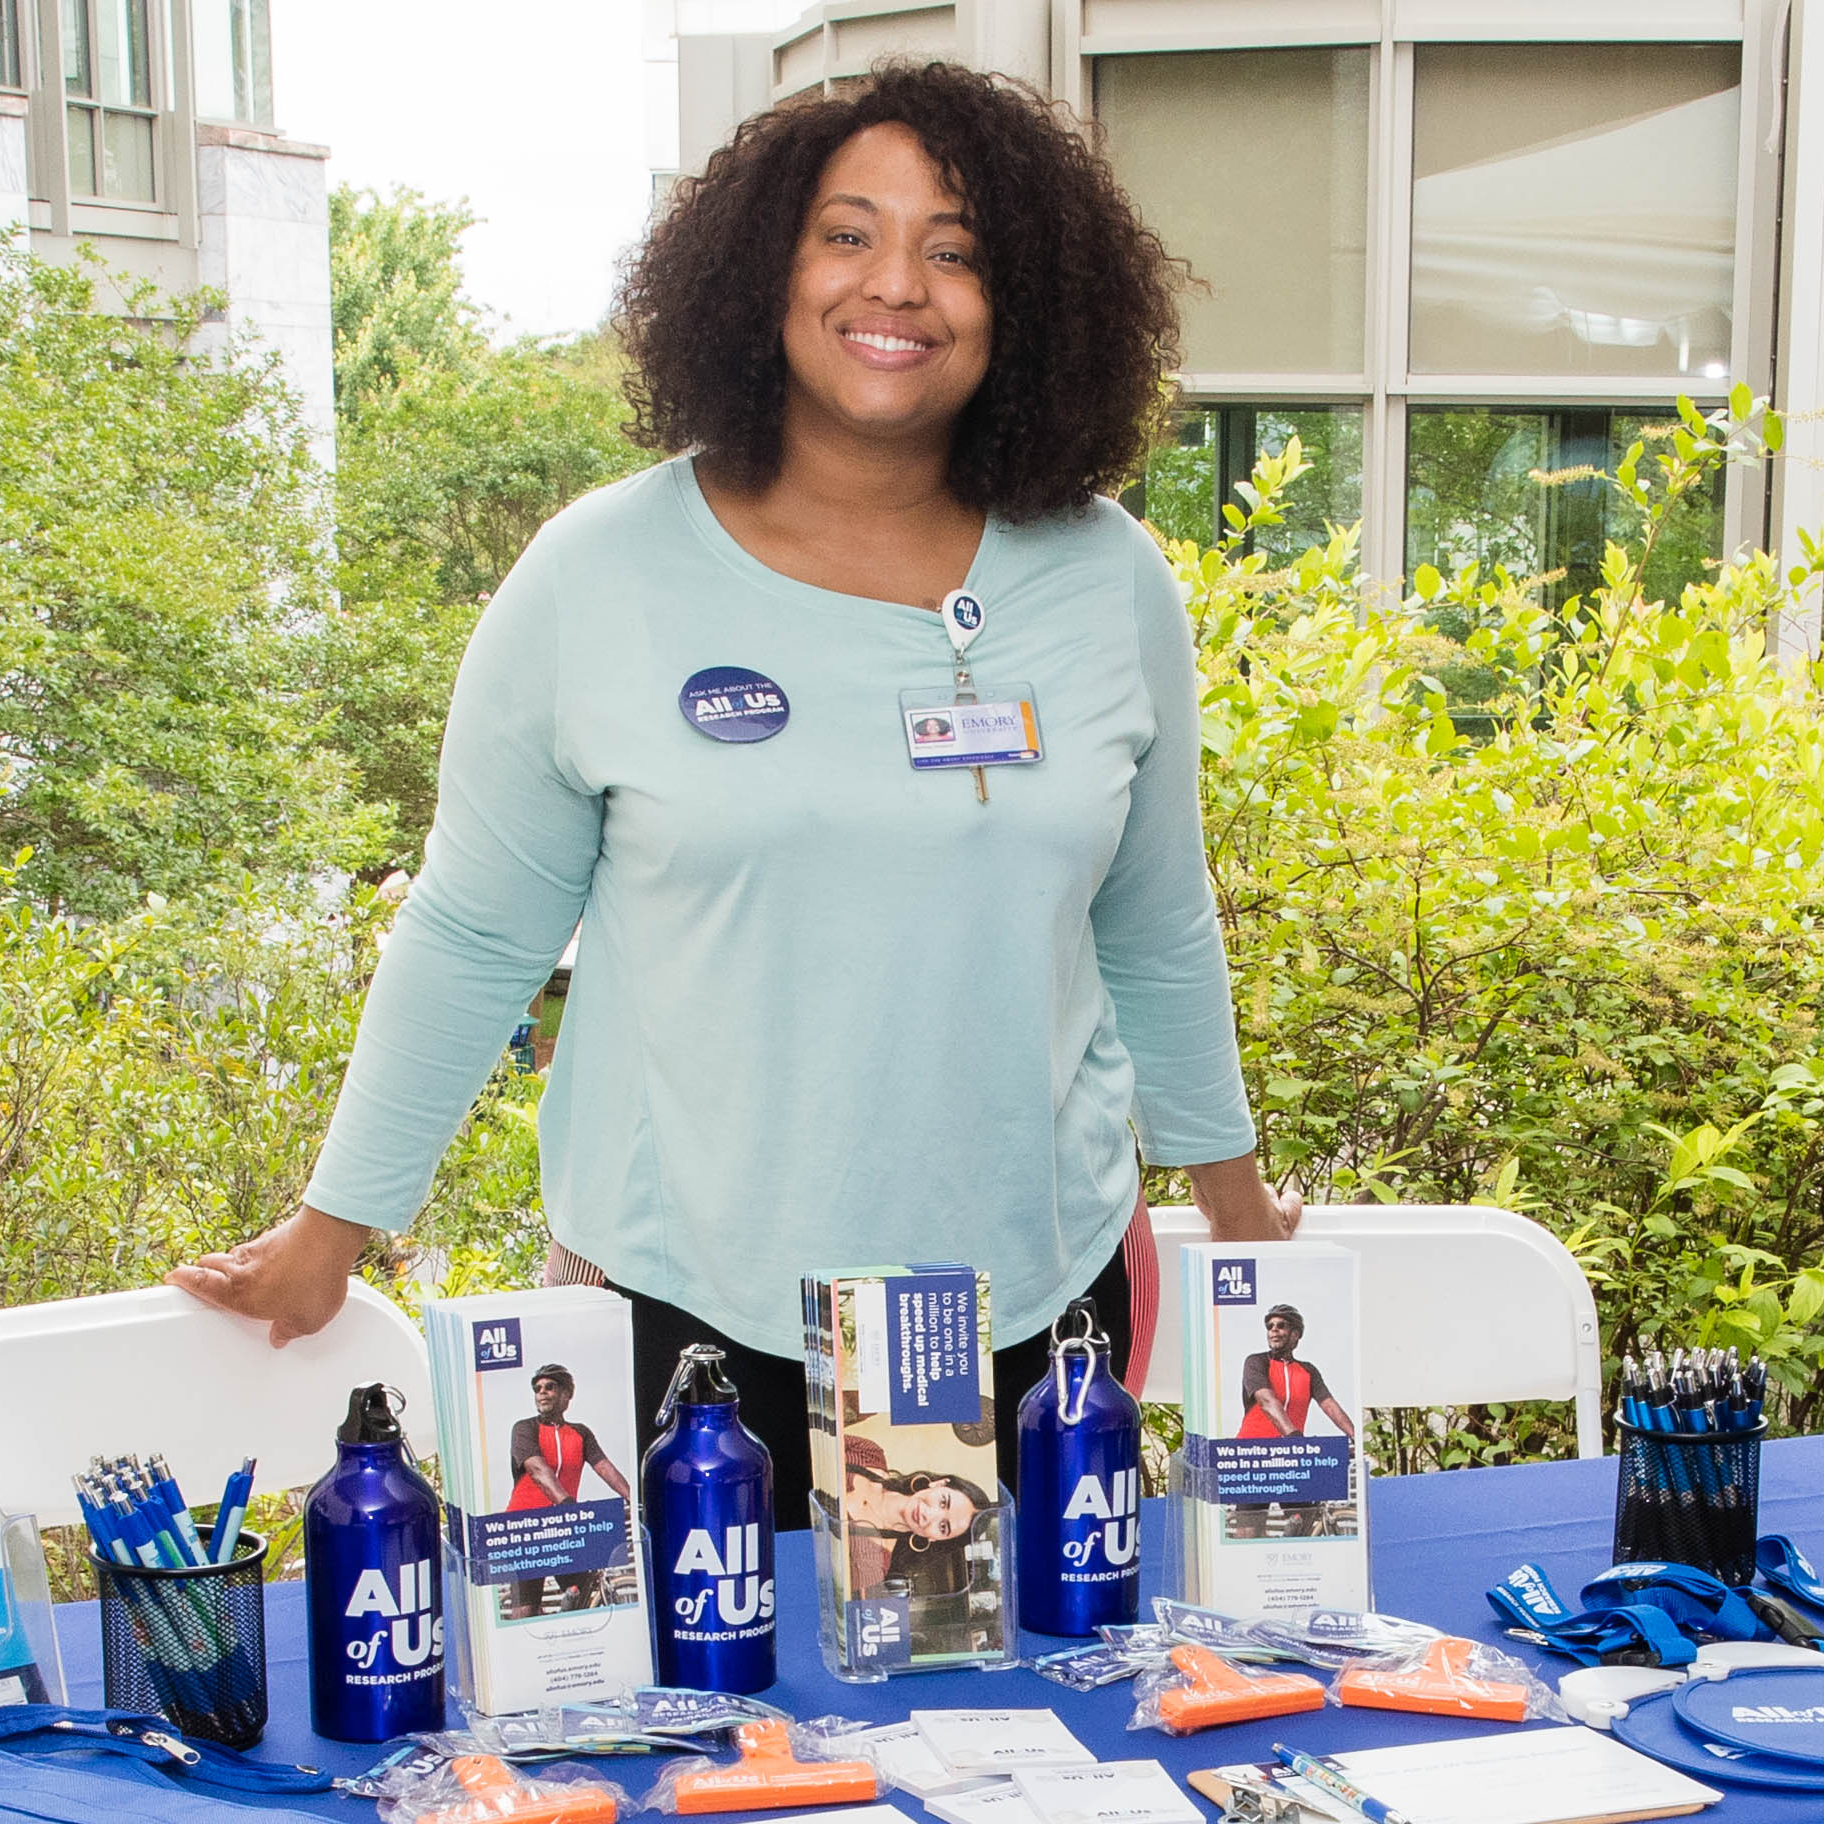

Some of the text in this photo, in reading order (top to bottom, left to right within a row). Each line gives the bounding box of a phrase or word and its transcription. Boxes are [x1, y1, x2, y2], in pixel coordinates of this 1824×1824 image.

[956, 599, 973, 612] All
[964, 612, 977, 625] Us
[689, 690, 706, 698] ASK
[724, 684, 753, 693] ABOUT
[696, 696, 733, 716] All
[743, 692, 781, 708] Us
[698, 707, 785, 722] RESEARCH PROGRAM
[961, 715, 1017, 729] EMORY
[1218, 1266, 1242, 1281] All
[1218, 1280, 1252, 1294] of Us
[942, 1292, 953, 1305] to
[943, 1308, 954, 1325] be
[479, 1327, 507, 1345] All
[928, 1292, 942, 1380] million to help
[944, 1328, 953, 1351] one
[957, 1291, 969, 1375] We invite you
[480, 1343, 517, 1359] of Us
[899, 1294, 913, 1393] breakthroughs.
[912, 1292, 929, 1406] speed up medical
[945, 1354, 956, 1366] in
[1216, 1444, 1321, 1457] We invite you to be
[1217, 1456, 1338, 1469] one in a million to help
[1217, 1470, 1310, 1483] speed up medical
[1062, 1467, 1137, 1520] All
[1218, 1483, 1298, 1495] breakthroughs.
[485, 1510, 594, 1533] We invite you to be
[486, 1520, 614, 1547] one in a million to help
[487, 1538, 585, 1561] speed up medical
[674, 1522, 759, 1576] All
[1063, 1531, 1102, 1567] of
[489, 1554, 573, 1574] breakthroughs.
[1061, 1571, 1119, 1582] RESEARCH
[1508, 1569, 1529, 1587] Us
[345, 1558, 431, 1617] All
[675, 1575, 775, 1626] of Us
[1522, 1589, 1554, 1615] All
[880, 1607, 900, 1642] All
[1181, 1614, 1223, 1633] All
[1313, 1613, 1361, 1626] All
[346, 1612, 444, 1669] of Us
[674, 1630, 736, 1642] RESEARCH
[861, 1609, 880, 1656] of Us
[345, 1672, 411, 1686] RESEARCH
